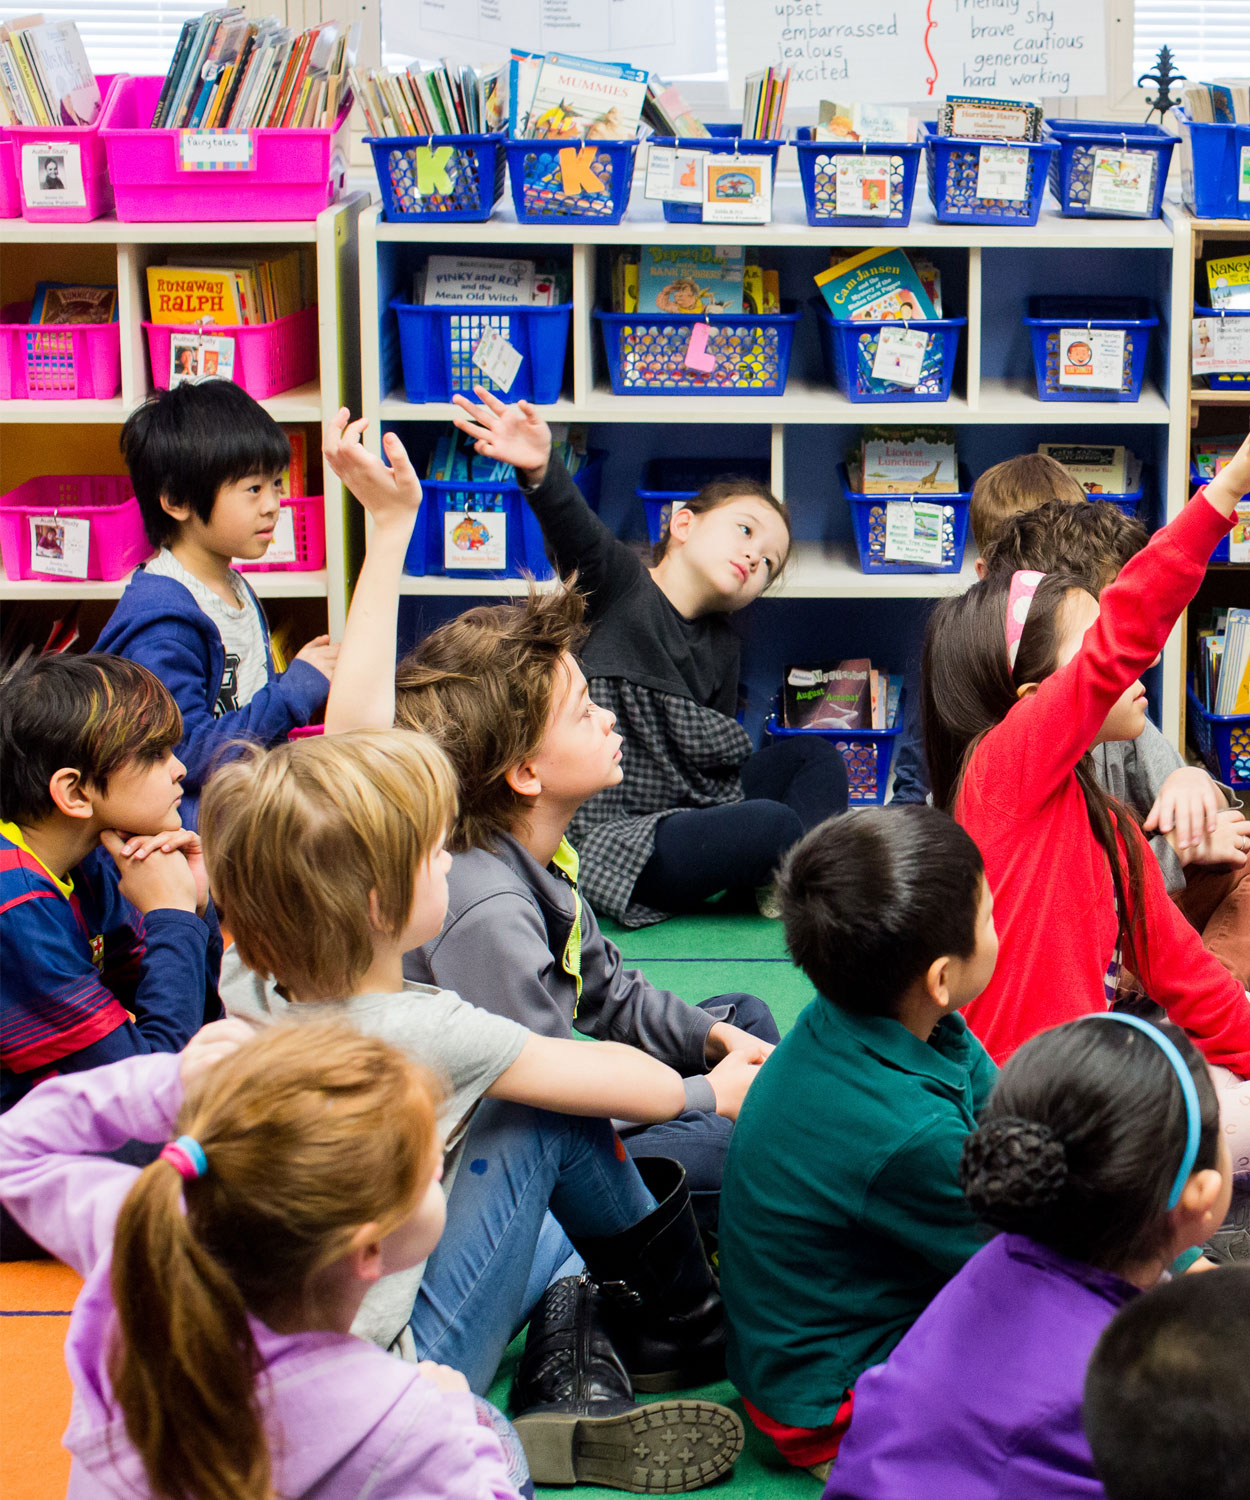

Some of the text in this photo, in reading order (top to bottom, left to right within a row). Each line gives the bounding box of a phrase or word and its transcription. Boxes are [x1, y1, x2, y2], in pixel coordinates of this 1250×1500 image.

[775, 0, 823, 26] upset
[1025, 2, 1055, 31] shy
[782, 13, 898, 41] embarrassed
[971, 16, 1015, 38] brave
[1013, 31, 1084, 51] cautious
[777, 42, 842, 63] jealous
[974, 53, 1048, 72] generous
[635, 71, 645, 82] 3
[790, 58, 849, 82] xcited
[963, 63, 1070, 93] hard working
[558, 74, 630, 98] MUMMIES
[962, 110, 1020, 122] Horrible Harry
[187, 136, 239, 151] fairytales
[416, 146, 454, 195] K
[559, 146, 605, 196] K
[436, 272, 472, 284] PINKY
[474, 273, 495, 283] and
[1209, 261, 1250, 279] NANCY
[834, 265, 900, 305] Cam Jansen
[435, 291, 518, 302] Mean Old Witch
[685, 322, 716, 373] L
[878, 455, 931, 468] Lunchtime
[796, 687, 825, 701] August
